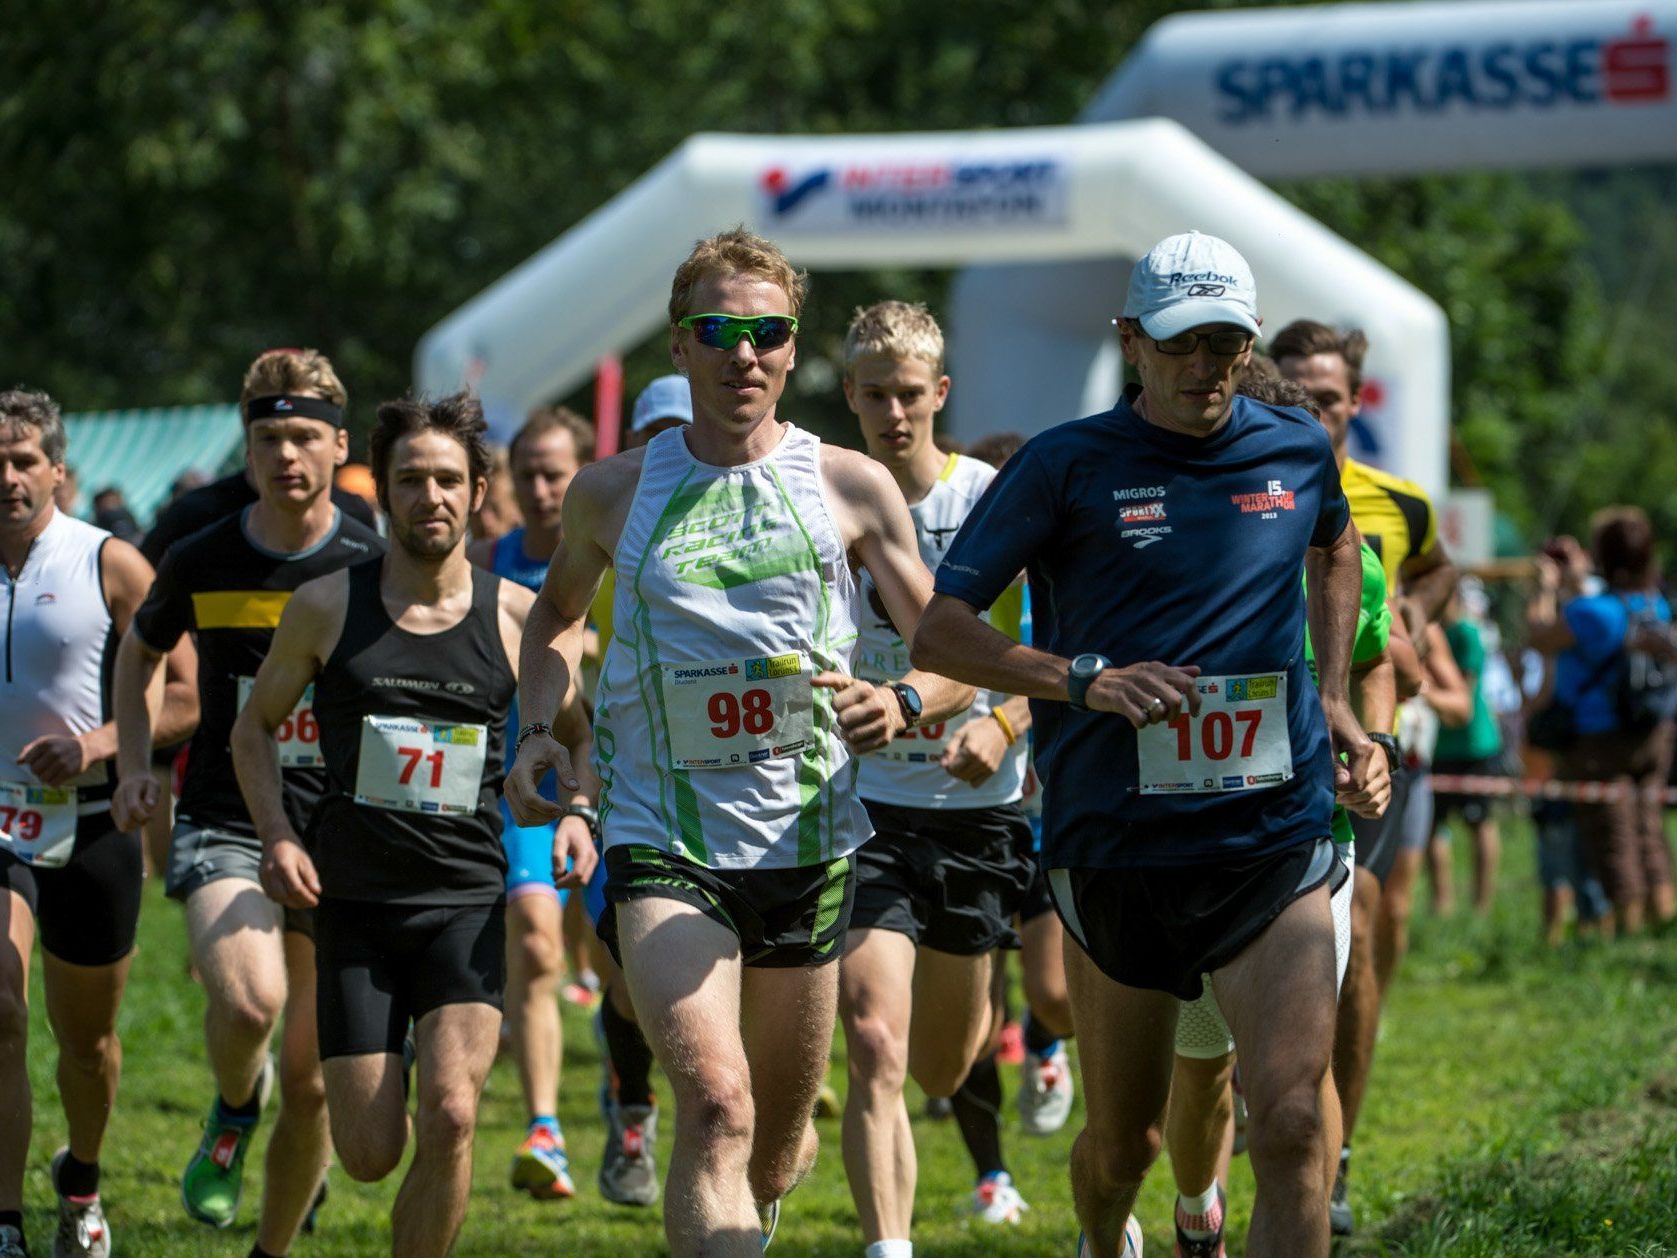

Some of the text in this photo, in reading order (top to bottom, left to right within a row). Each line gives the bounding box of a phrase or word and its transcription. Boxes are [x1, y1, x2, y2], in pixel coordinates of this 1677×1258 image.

[1216, 37, 1601, 126] SPARKASSE
[1169, 271, 1238, 287] Reebok
[1113, 485, 1166, 501] MIGROS
[1121, 526, 1173, 539] BROOKS
[371, 677, 439, 690] SALOMON
[674, 666, 728, 679] SPARKASSE
[707, 688, 774, 739] 98
[1168, 709, 1263, 761] 107
[397, 746, 445, 788] 71
[0, 805, 42, 841] 79
